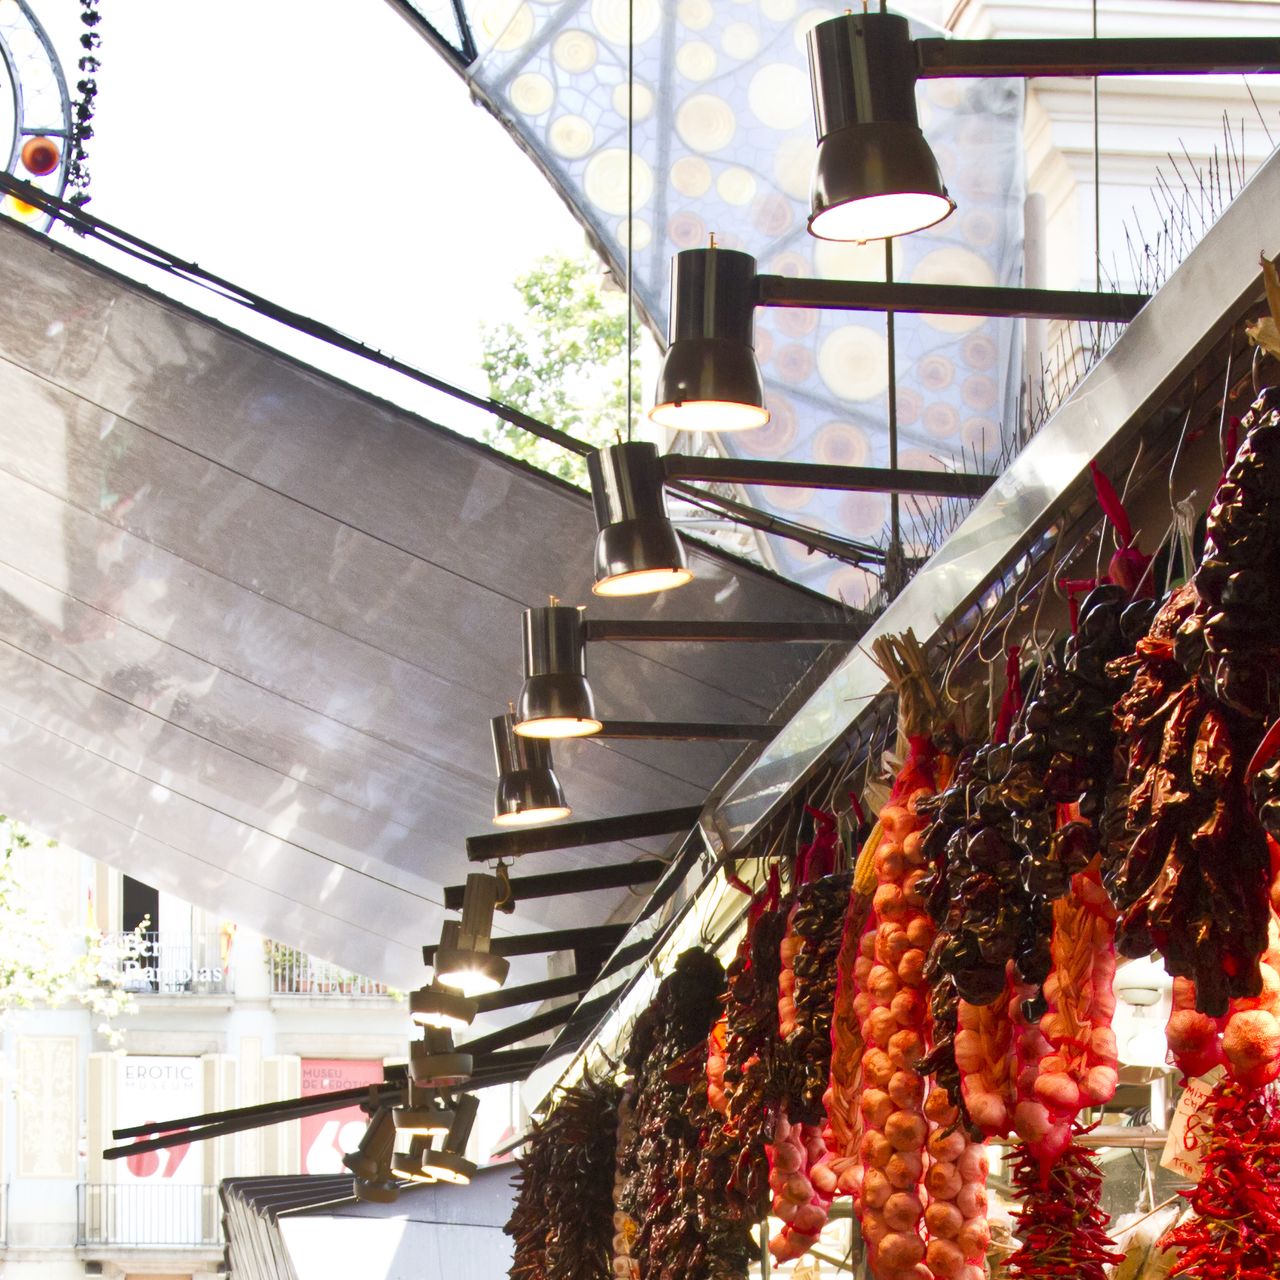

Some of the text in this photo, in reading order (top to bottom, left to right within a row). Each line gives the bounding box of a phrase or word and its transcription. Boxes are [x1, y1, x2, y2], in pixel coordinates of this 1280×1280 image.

[125, 1065, 193, 1080] EROTIC
[303, 1068, 342, 1079] MUSEU
[303, 1079, 318, 1090] DE
